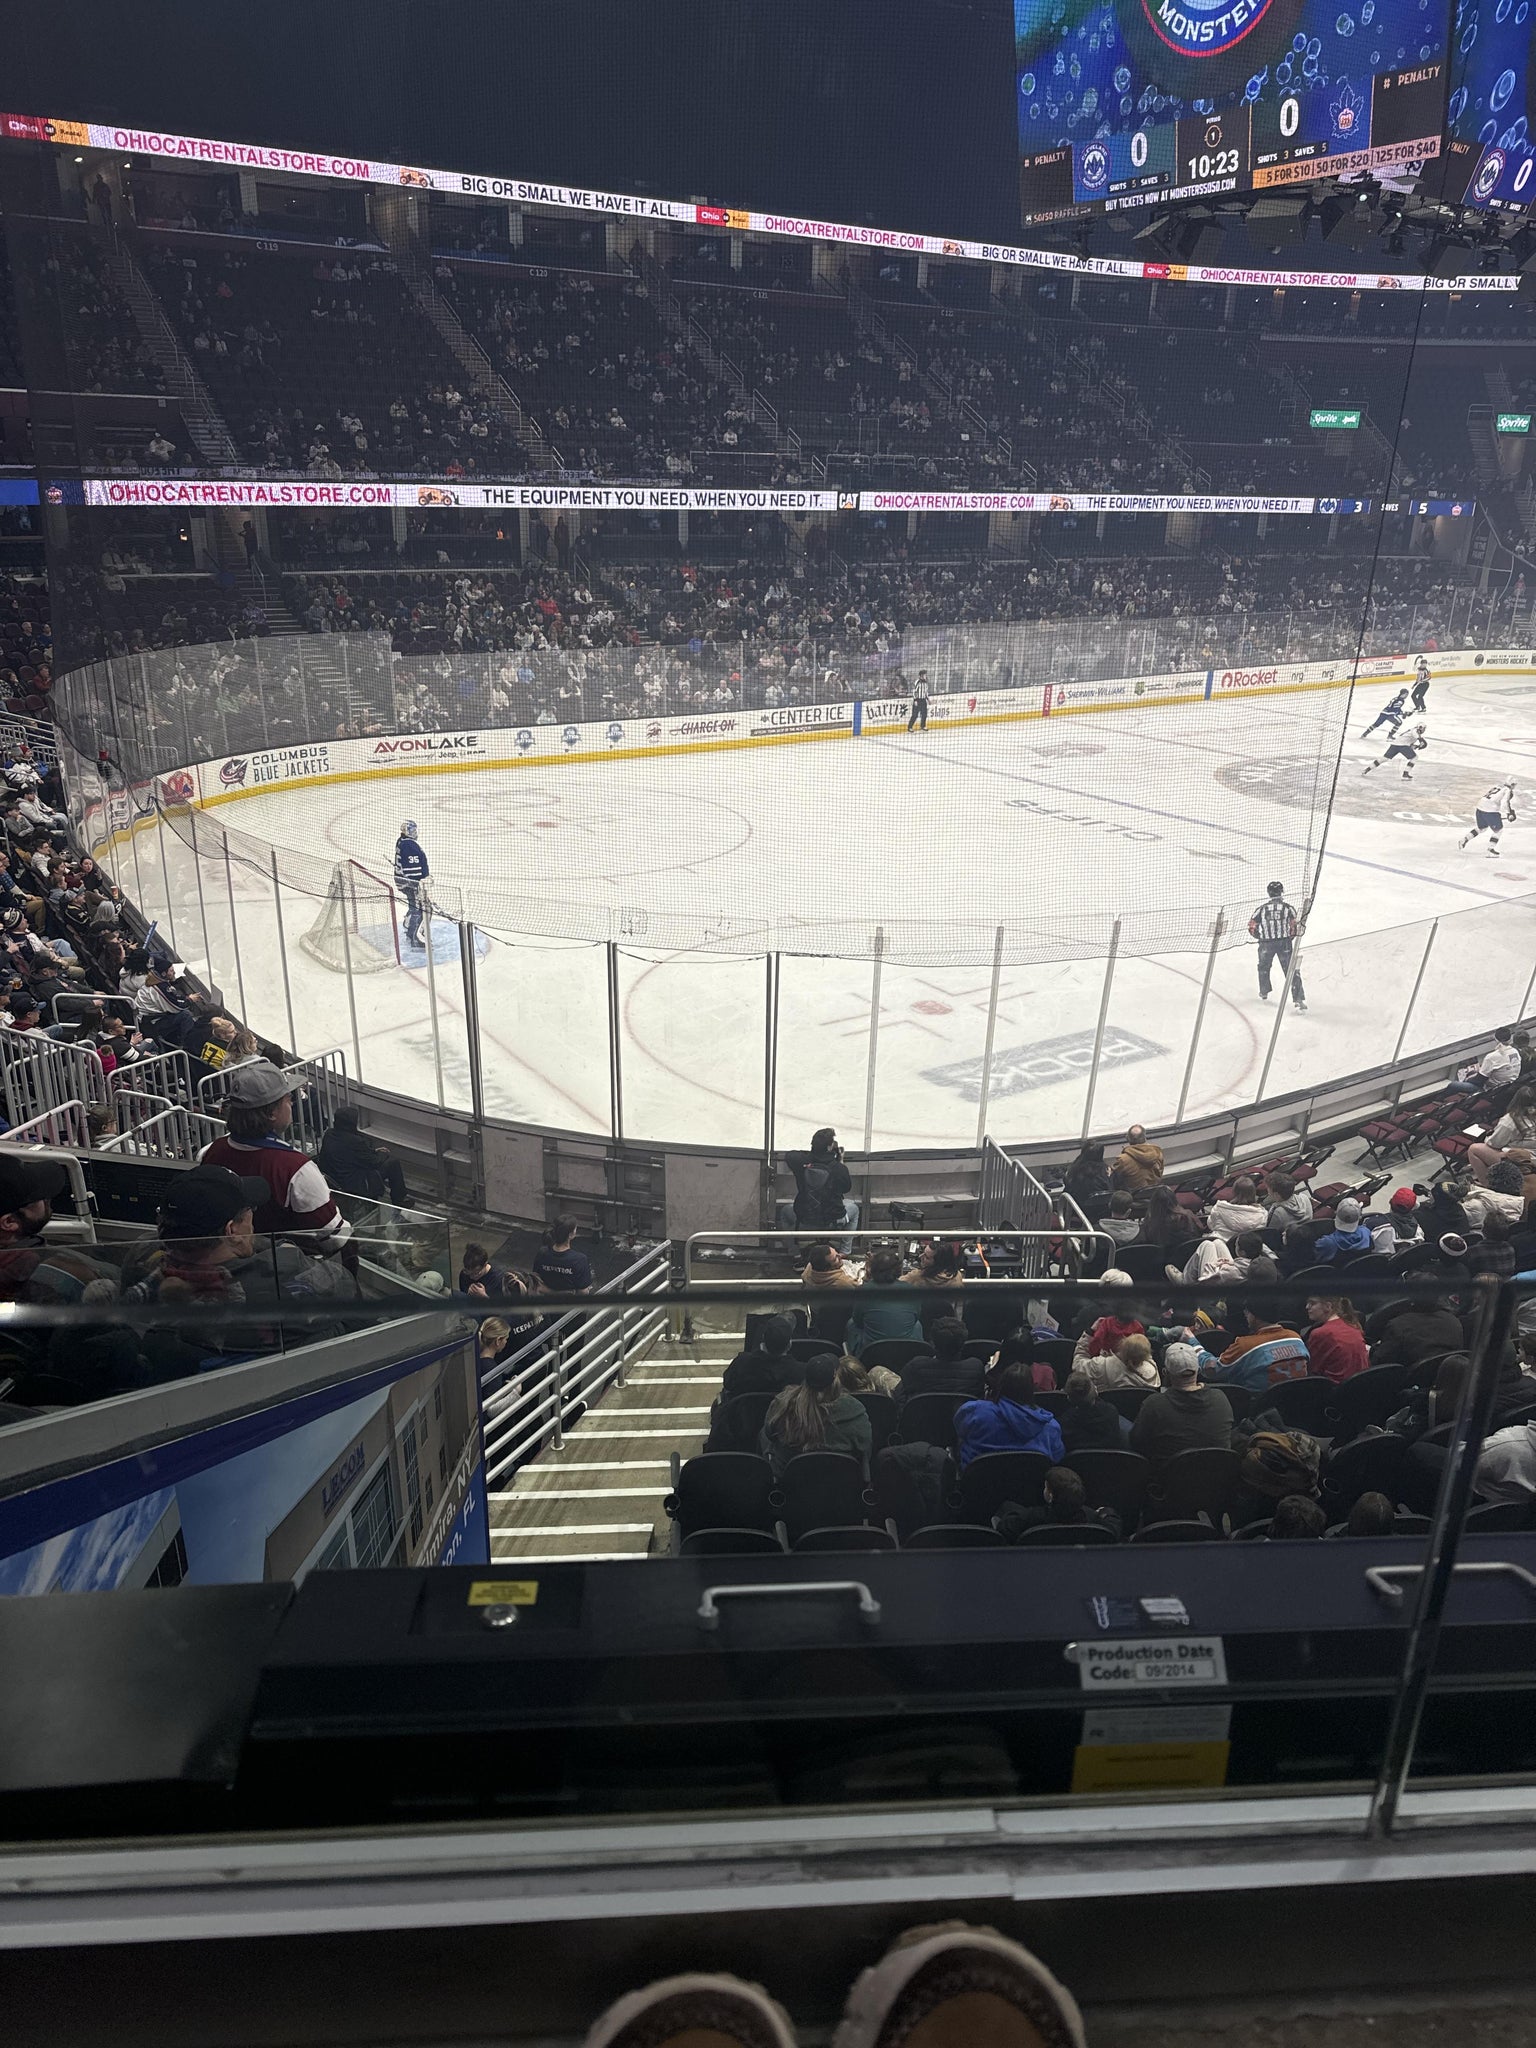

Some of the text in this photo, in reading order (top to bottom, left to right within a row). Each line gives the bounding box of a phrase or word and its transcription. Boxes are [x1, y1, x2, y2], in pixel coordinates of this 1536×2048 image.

[1398, 65, 1441, 86] PENALTY
[8, 120, 38, 133] Ohio
[1280, 98, 1299, 137] 0
[114, 130, 370, 179] OHIOCATRENTALSTORE.COM
[1034, 151, 1066, 166] PENALTY
[1131, 132, 1148, 168] 0
[1257, 152, 1278, 164] SHOTS
[1294, 146, 1315, 158] SAVES
[1188, 149, 1240, 180] 10:23
[1266, 140, 1436, 183] 5 FOR $10 50 FOR $20 125 FOR $40
[1513, 158, 1534, 192] 0
[461, 176, 679, 218] BIG OR SMALL WE HAVE IT ALL.
[1109, 182, 1127, 192] SHOTS
[1105, 199, 1117, 212] BUY
[1119, 195, 1144, 209] TICKETS
[1145, 191, 1160, 205] NOW
[1160, 189, 1169, 202] AT
[701, 211, 720, 221] Ohio
[765, 216, 924, 250] OHIOCATRENTALSTORE.COM
[982, 245, 1128, 274] BIG OR SMALL WE HAVE IT ALL.
[1147, 267, 1163, 275] Ohio
[1200, 268, 1357, 287] OHIOCATRENTALSTORE.COM
[1423, 276, 1446, 289] BIG
[1448, 276, 1467, 289] OR
[1469, 276, 1513, 289] SMALL
[1313, 413, 1338, 424] Sprite
[1497, 416, 1529, 430] Sprite
[110, 483, 392, 504] OHIOCATRENTALSTORE.COM
[482, 489, 823, 509] THE EQUIPMENT YOU NEED, WHEN YOU NEED IT.
[839, 493, 859, 509] CAT
[873, 495, 1035, 509] OHIOCATRENTALSTORE.COM
[1087, 497, 1107, 509] THE
[1109, 497, 1164, 510] EQUIPMENT
[1165, 498, 1185, 510] YOU
[1186, 498, 1213, 512] NEED,
[1214, 499, 1241, 511] WHEN
[1241, 499, 1260, 511] YOU
[1261, 500, 1288, 512] NEED
[1353, 502, 1428, 514] 3 SAVES 5
[1233, 668, 1279, 688] Rocket
[1067, 687, 1126, 700] SHERWIN-WILLIAMS
[771, 705, 845, 726] CENTER ICE
[252, 746, 328, 766] COLUMBUS
[253, 758, 330, 783] BLUE JACKETS
[408, 855, 420, 864] 35
[421, 1446, 472, 1567] lmira, NY
[463, 1490, 476, 1529] FL
[1087, 1644, 1214, 1662] Production Date
[1090, 1664, 1196, 1681] Code: 09/2014
